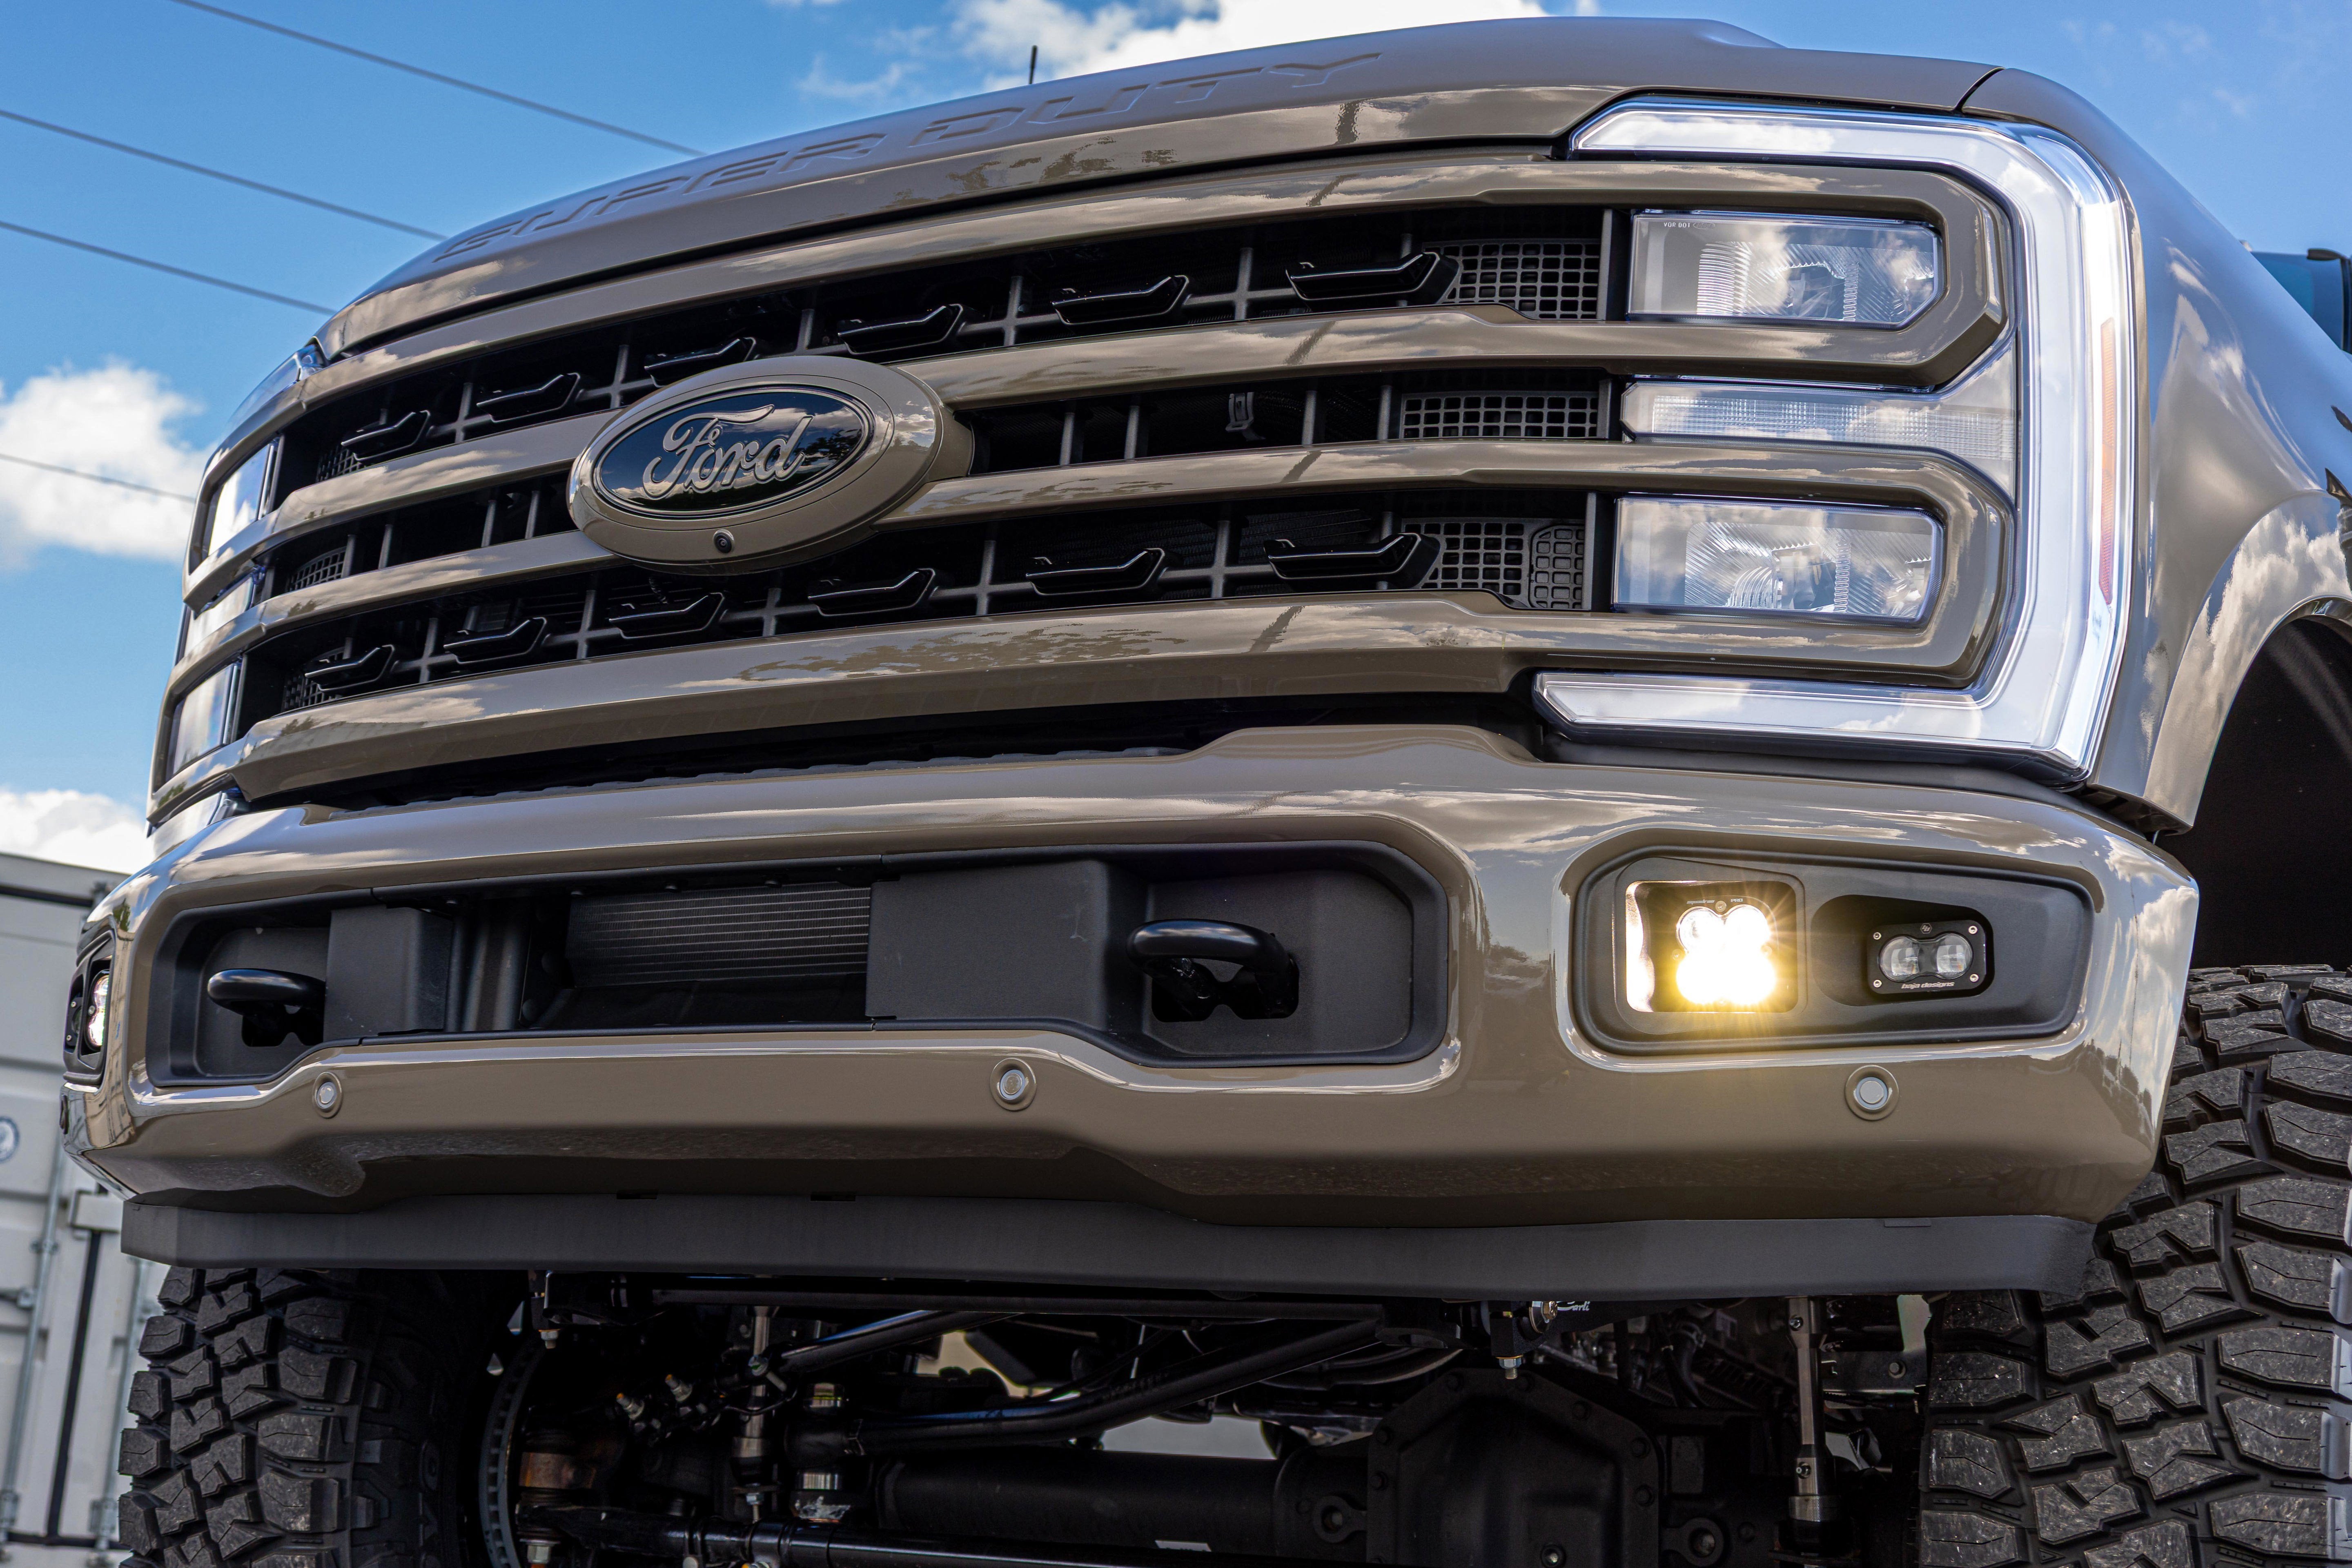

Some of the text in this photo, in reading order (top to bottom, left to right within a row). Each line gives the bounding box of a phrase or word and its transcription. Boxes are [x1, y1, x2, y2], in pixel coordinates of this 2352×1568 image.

[432, 52, 1383, 263] SUPER DUTY
[642, 404, 814, 498] Ford
